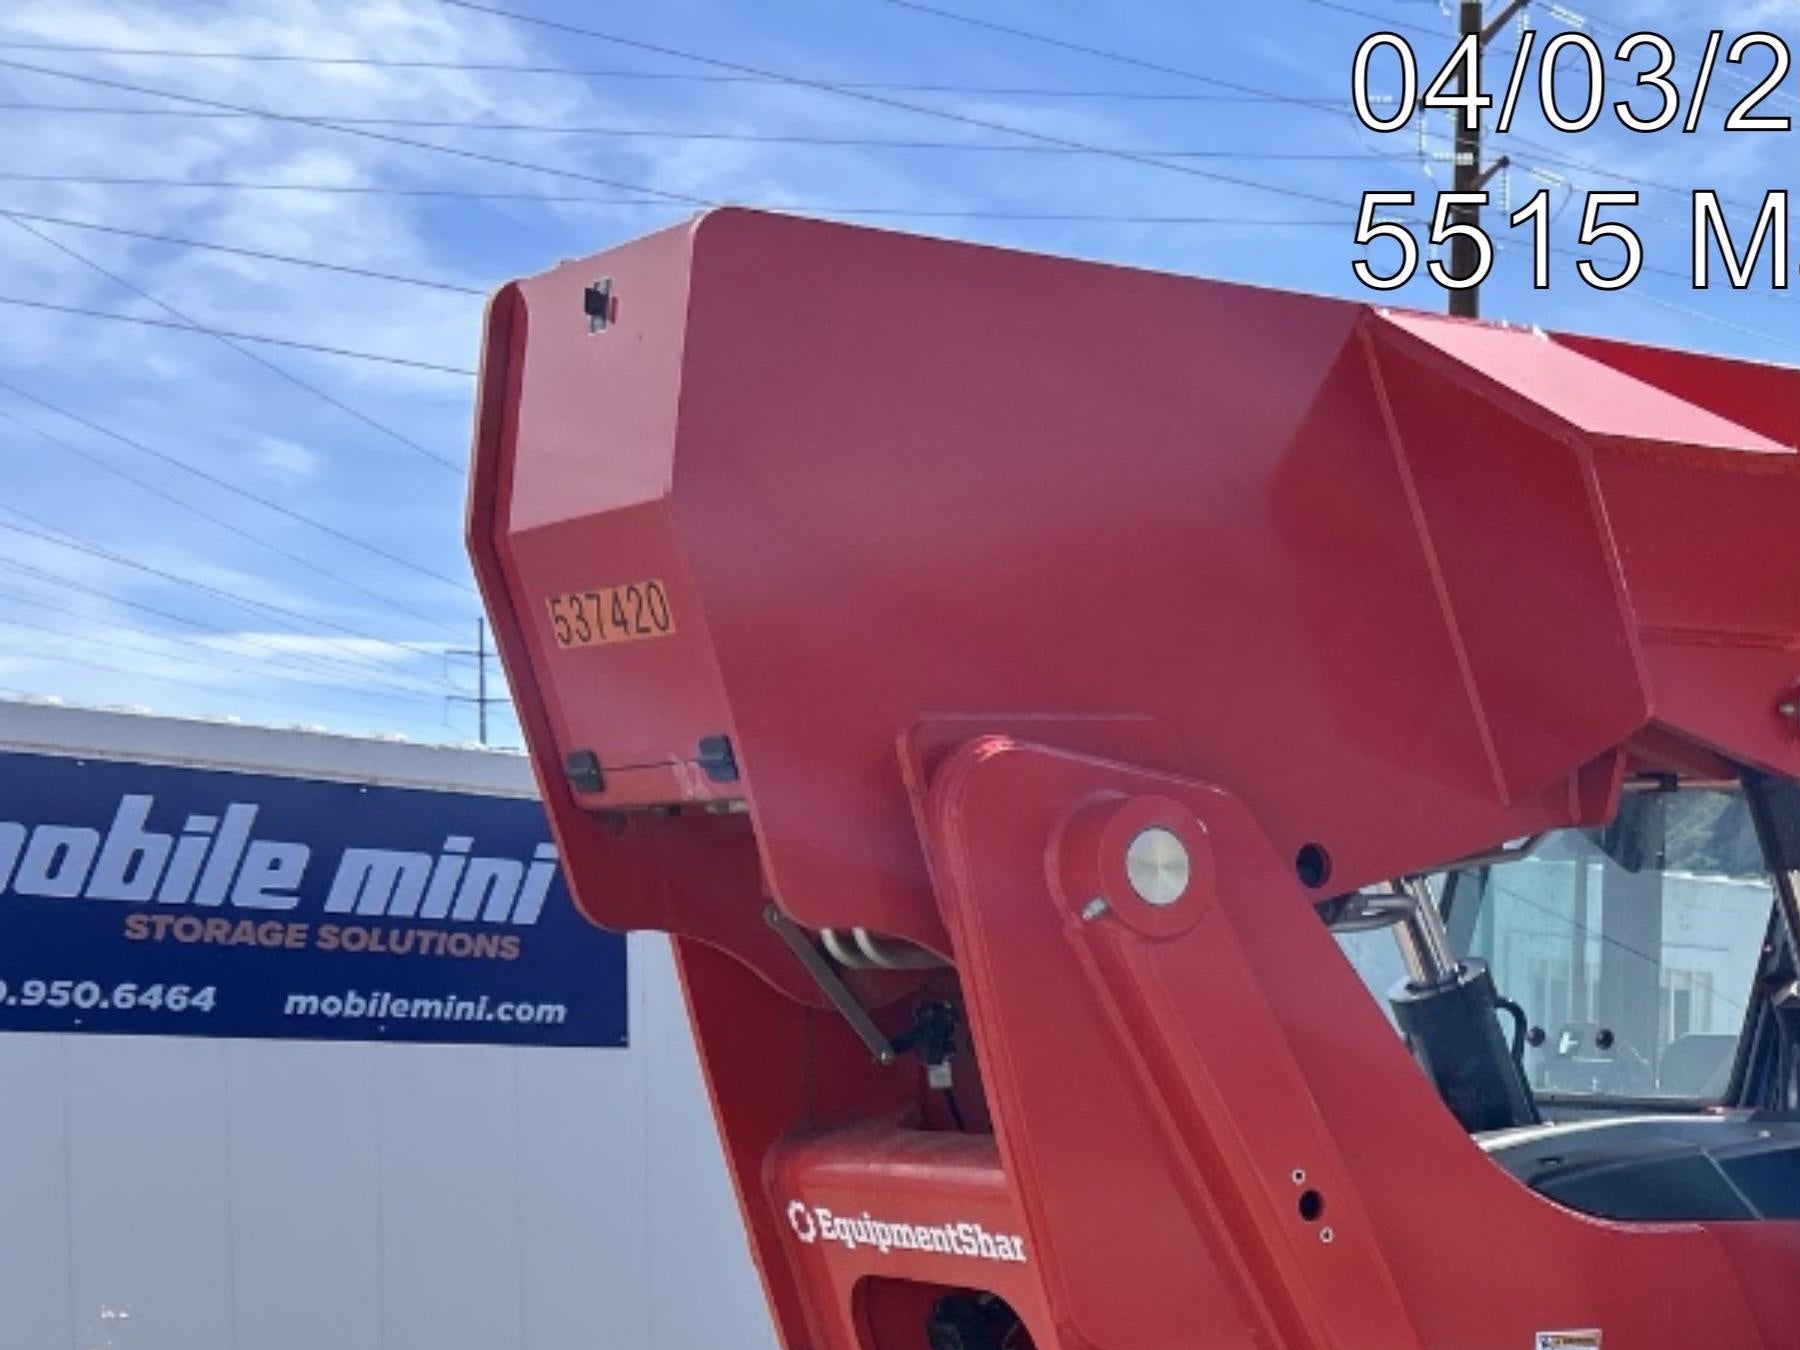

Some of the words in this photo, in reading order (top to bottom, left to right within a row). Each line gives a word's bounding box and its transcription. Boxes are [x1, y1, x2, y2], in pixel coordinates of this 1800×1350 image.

[550, 581, 670, 646] 537420
[323, 836, 557, 925] mini
[125, 913, 307, 950] STORAGE
[317, 924, 521, 960] SOLUTIONS
[284, 990, 567, 1024] mobilemini.com
[815, 1208, 1027, 1262] EquipmentShar
